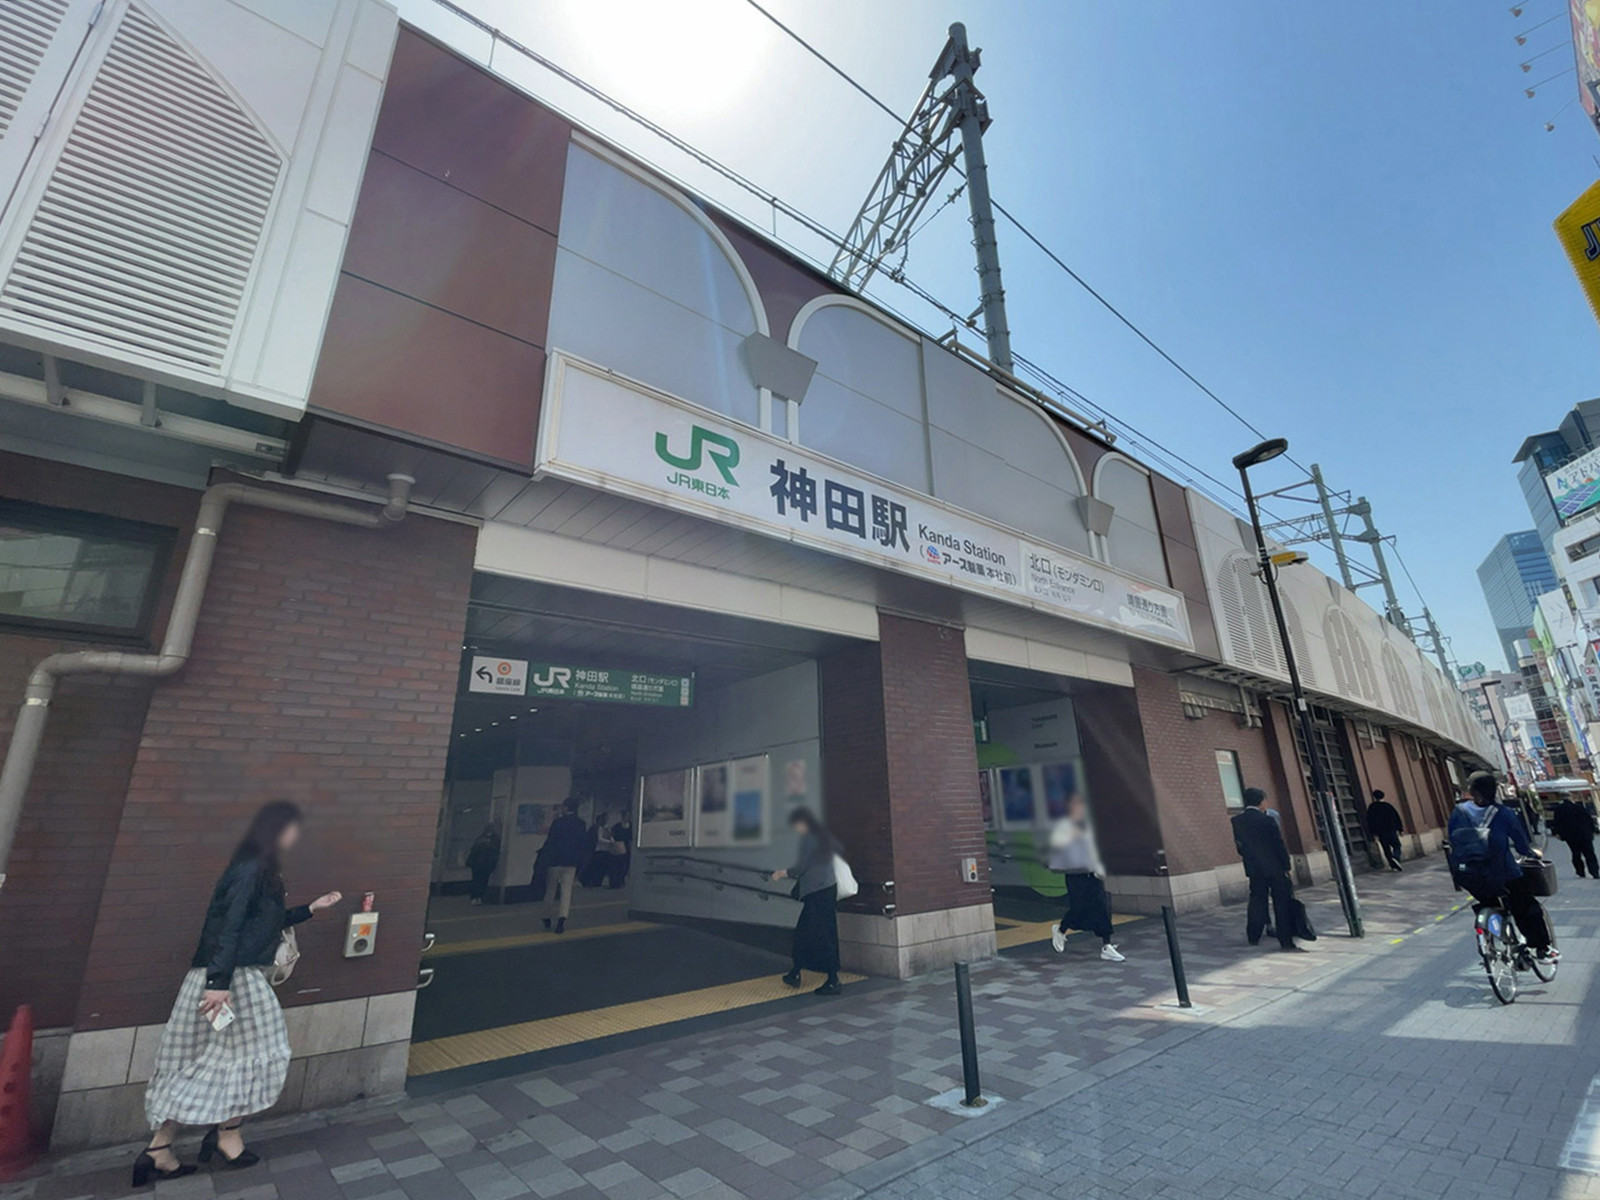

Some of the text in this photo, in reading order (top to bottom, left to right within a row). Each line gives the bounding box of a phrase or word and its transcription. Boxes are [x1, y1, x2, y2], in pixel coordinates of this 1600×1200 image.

[655, 424, 740, 487] JR
[666, 471, 731, 500] JR東日本
[769, 458, 911, 554] 神田駅
[918, 523, 1006, 566] Kanda Station
[533, 666, 572, 689] JR
[575, 669, 610, 684] 神田駅
